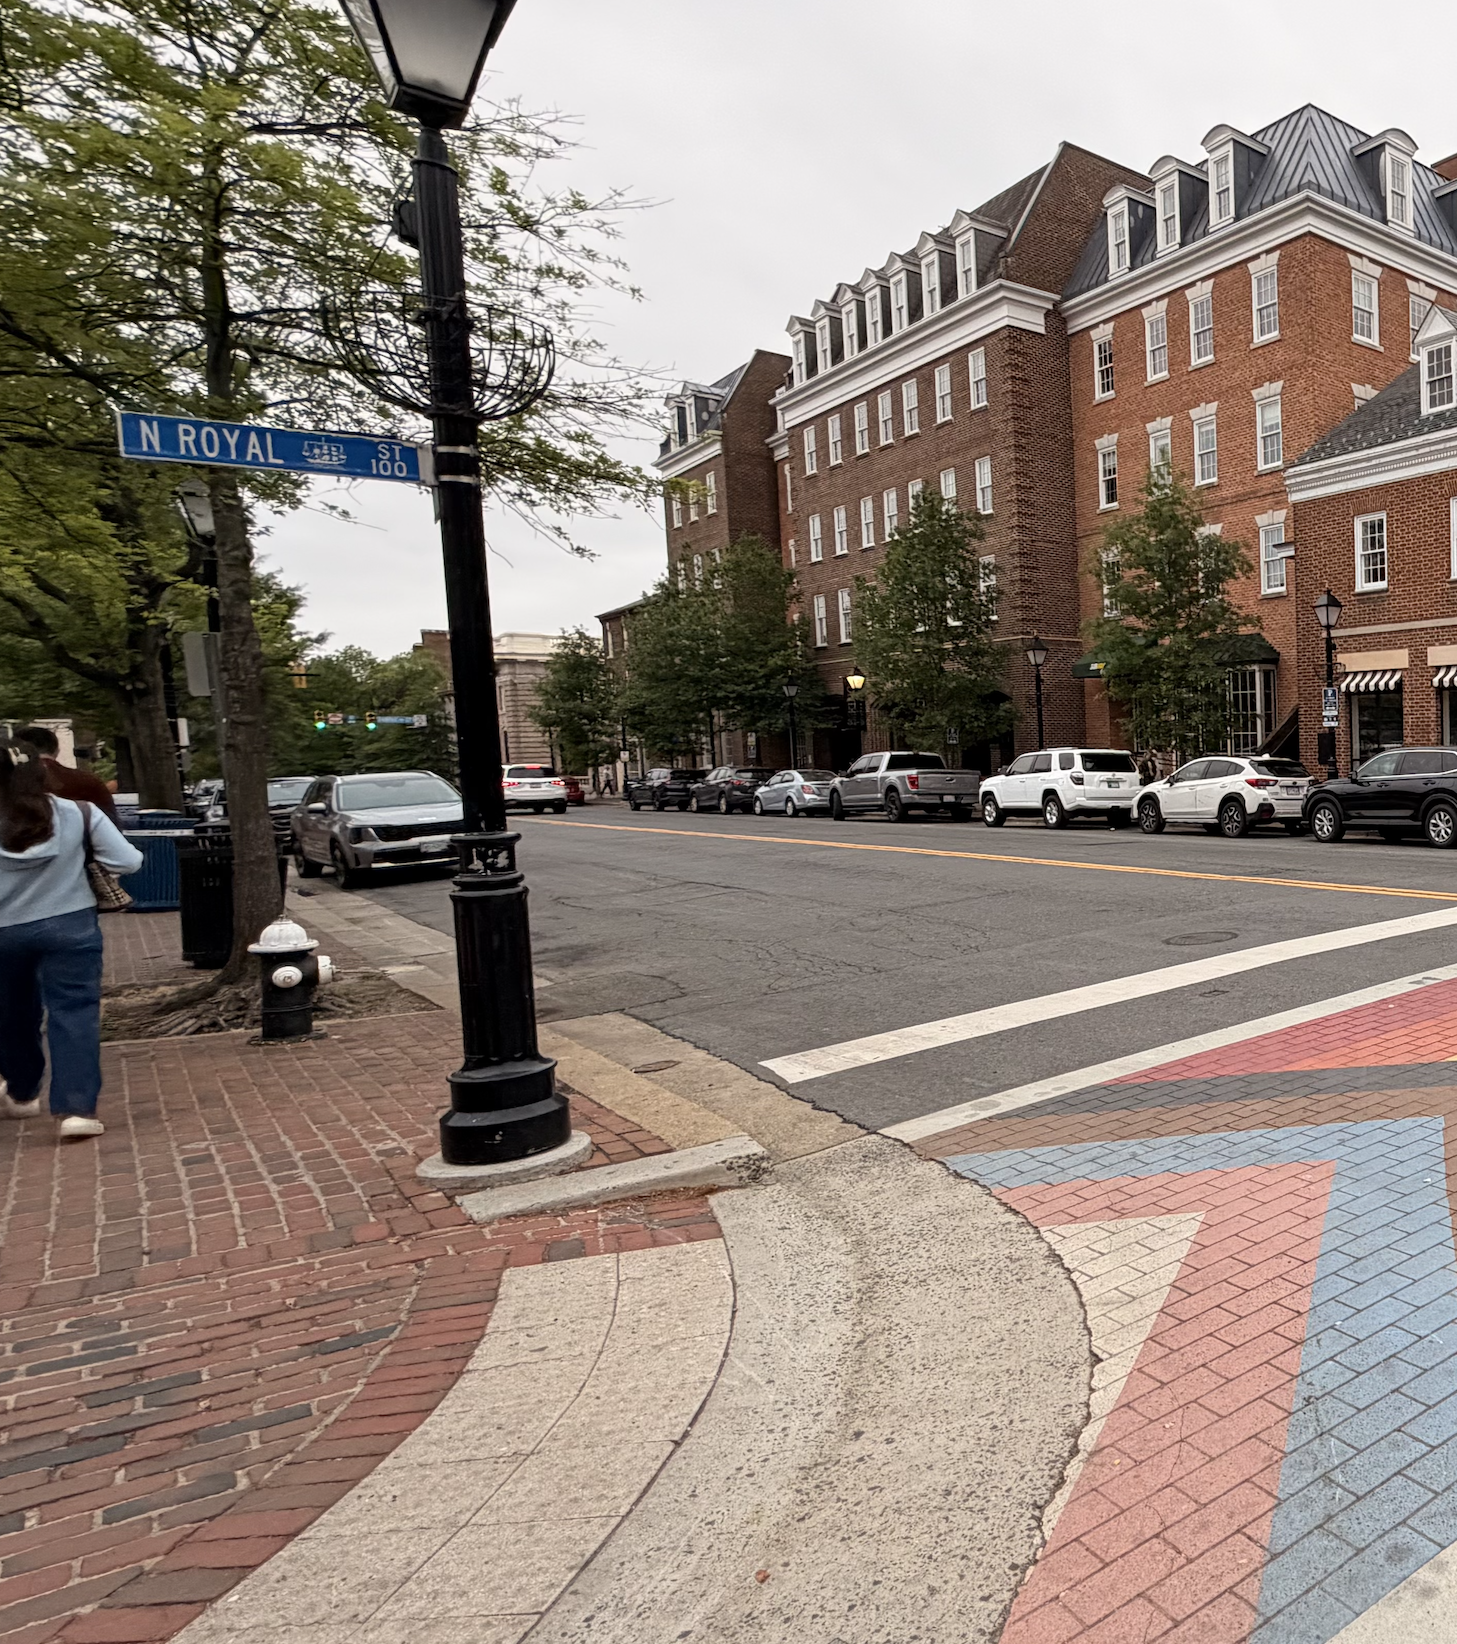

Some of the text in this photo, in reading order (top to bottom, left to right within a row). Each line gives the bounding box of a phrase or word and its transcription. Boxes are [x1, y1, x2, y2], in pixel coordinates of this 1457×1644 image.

[139, 419, 403, 465] N ROYAL ST
[371, 458, 408, 478] 100
